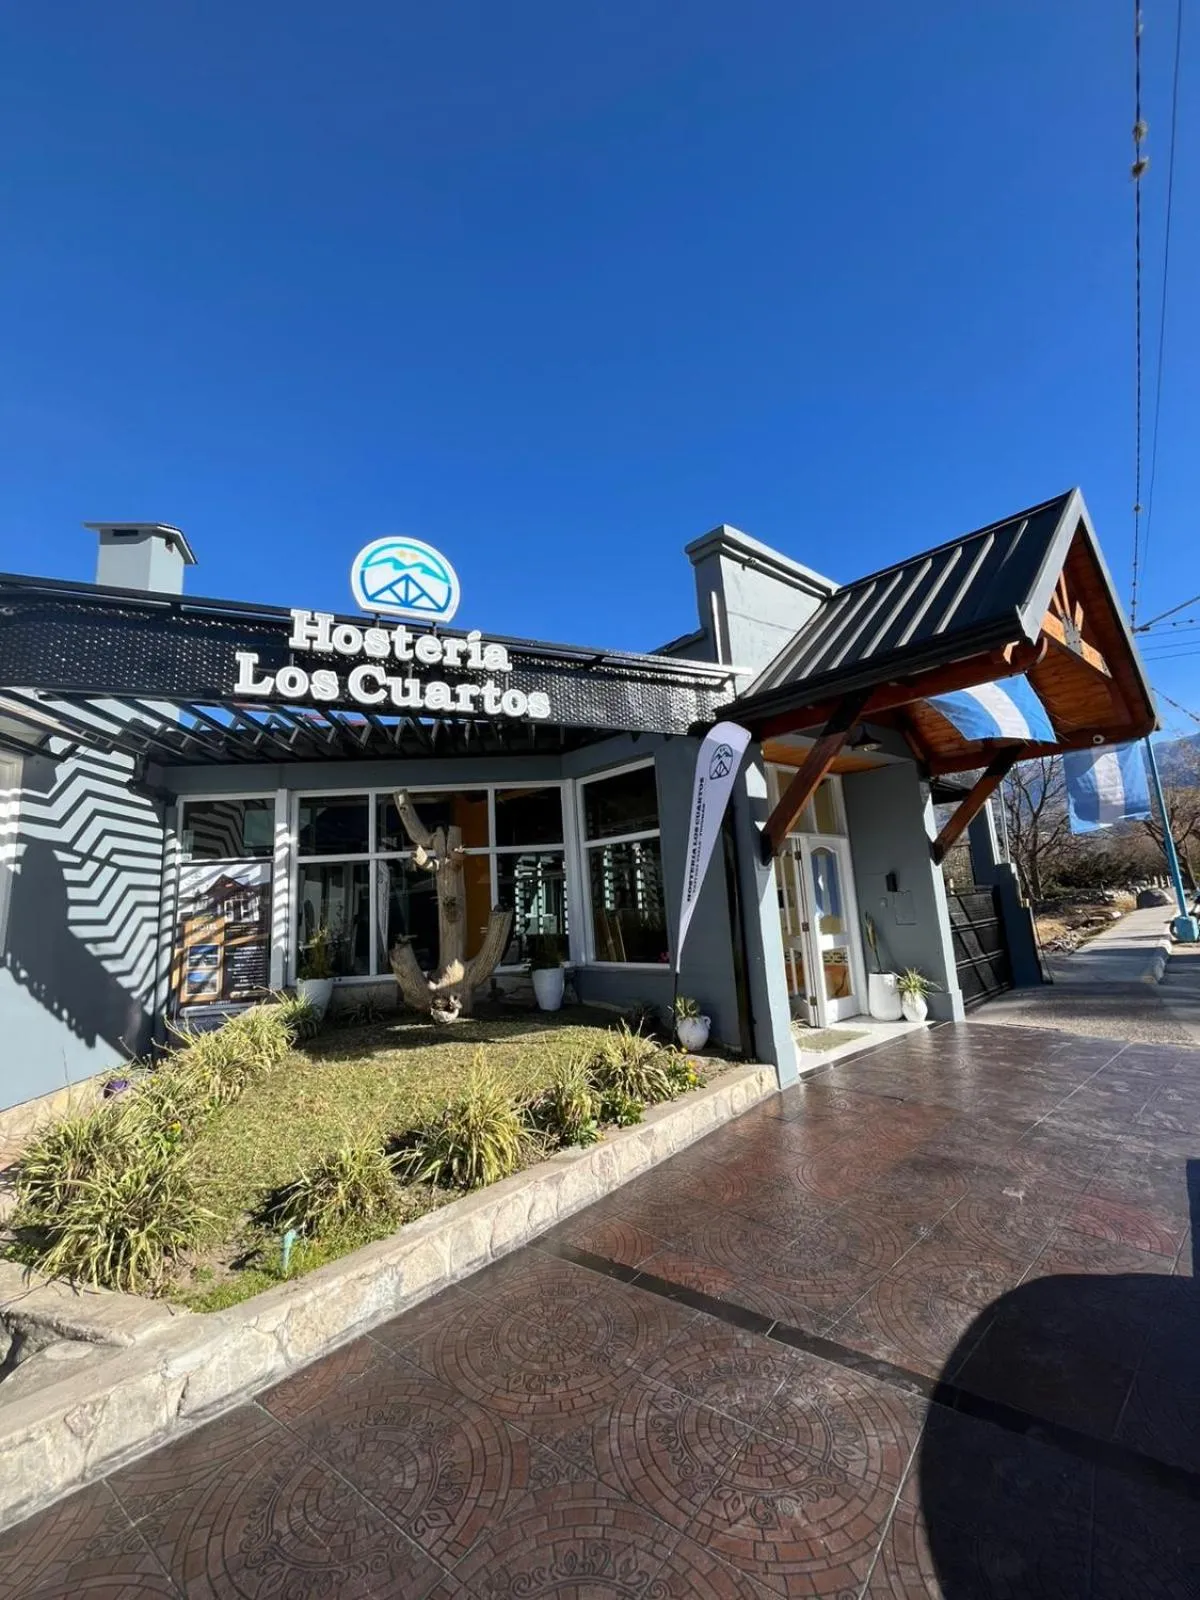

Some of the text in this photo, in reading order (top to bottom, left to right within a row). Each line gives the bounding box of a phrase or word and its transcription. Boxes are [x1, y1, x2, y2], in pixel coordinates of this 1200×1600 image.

[233, 652, 551, 719] Los Cuartos
[695, 777, 704, 826] CUARTOS
